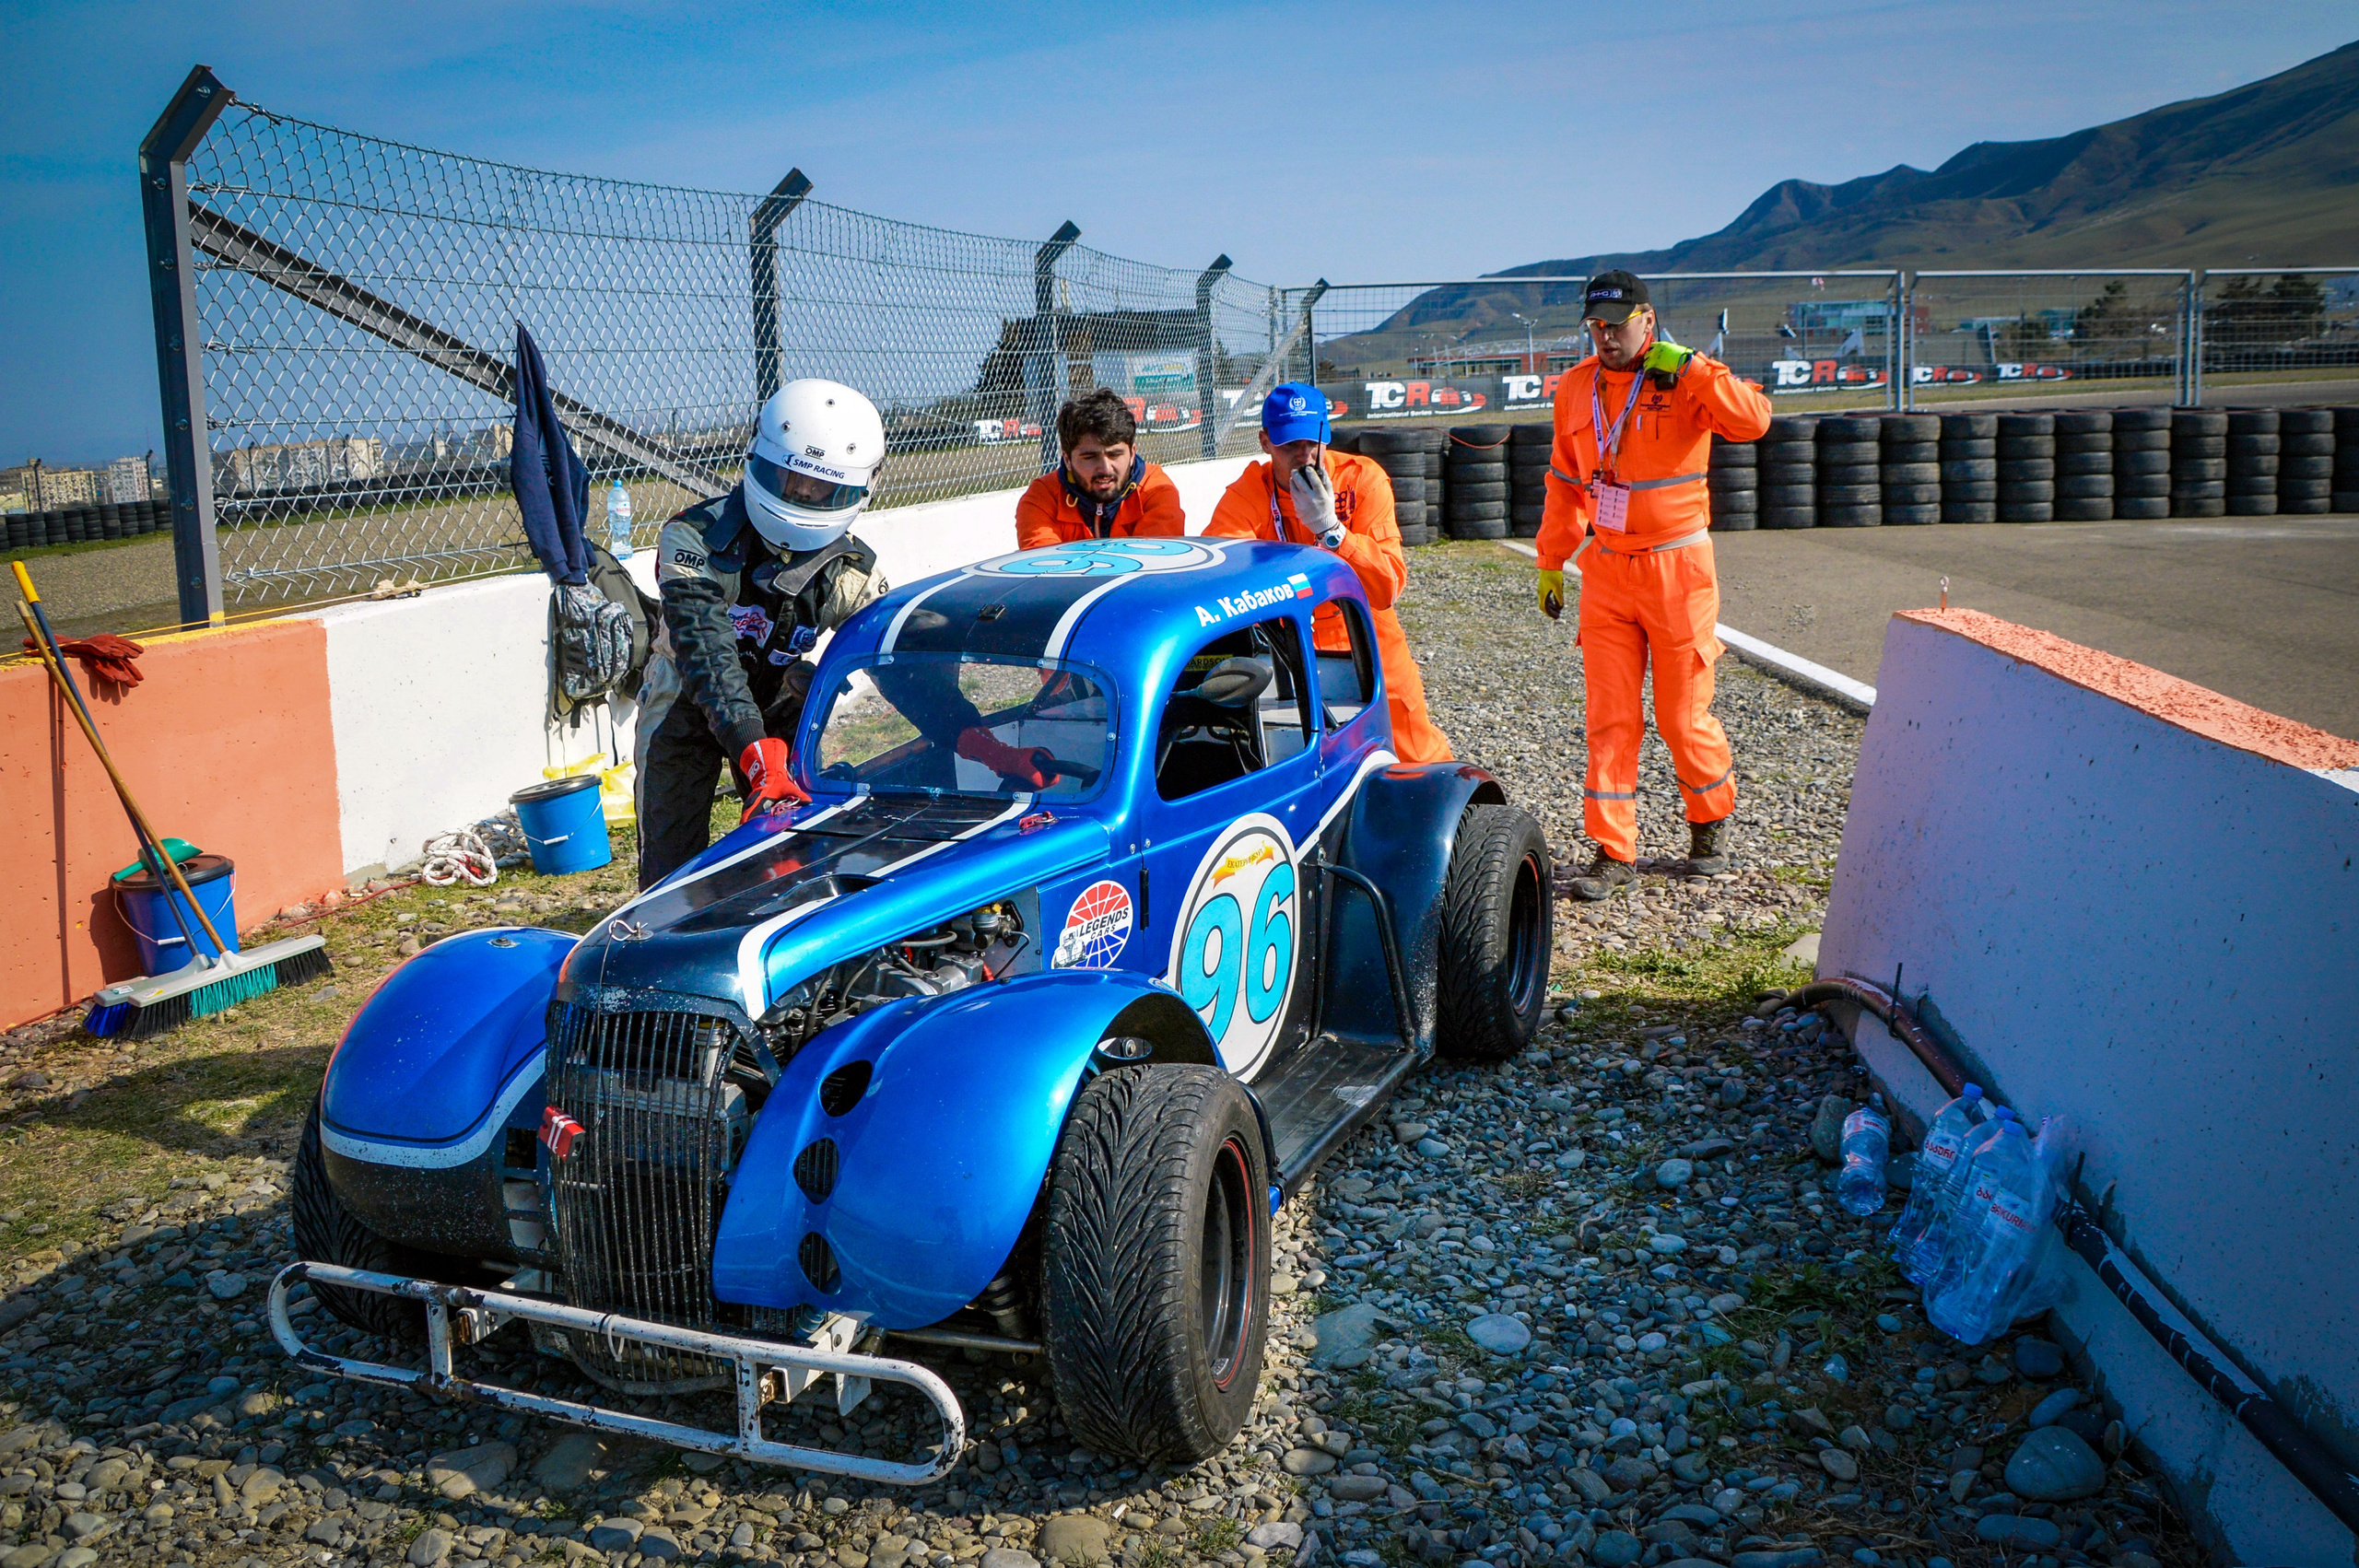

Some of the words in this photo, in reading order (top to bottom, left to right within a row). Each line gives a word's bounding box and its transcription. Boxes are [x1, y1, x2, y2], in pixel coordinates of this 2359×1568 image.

[1772, 360, 1837, 385] TCR
[1997, 363, 2038, 378] TCR
[1366, 381, 1430, 409] TCR
[805, 447, 825, 458] OMP
[792, 459, 814, 470] SMP
[813, 465, 845, 479] RACING
[675, 552, 705, 568] OMP
[1194, 605, 1221, 627] А.
[1216, 583, 1295, 617] Кабаков
[1079, 907, 1129, 937] LEGENDS
[1090, 924, 1117, 940] CARS
[1180, 860, 1295, 1045] 96
